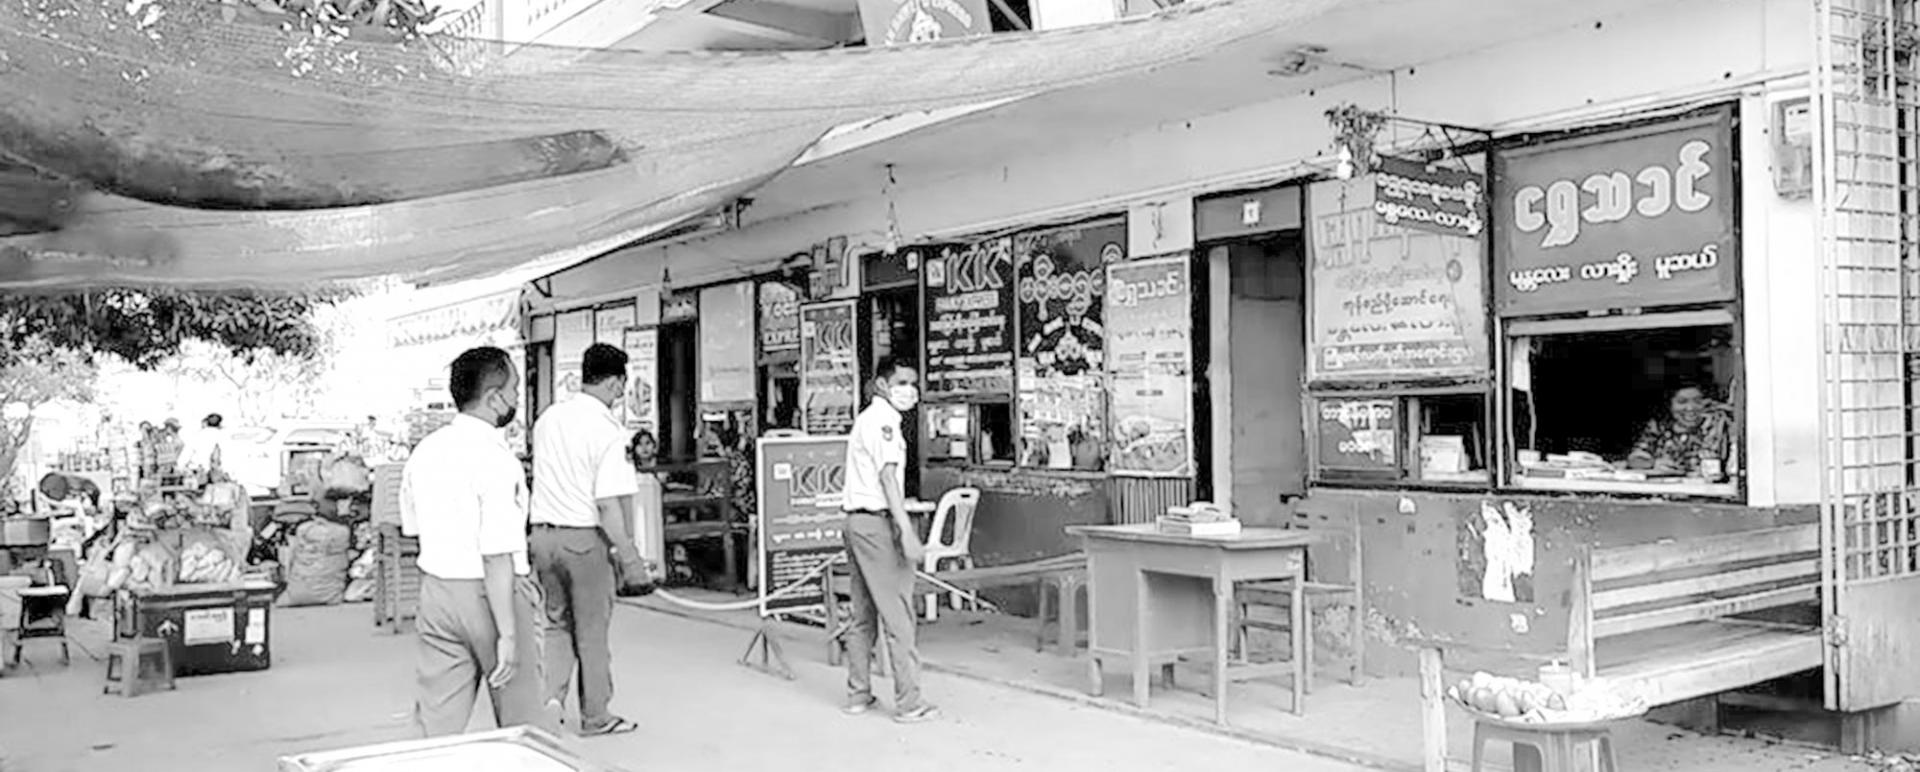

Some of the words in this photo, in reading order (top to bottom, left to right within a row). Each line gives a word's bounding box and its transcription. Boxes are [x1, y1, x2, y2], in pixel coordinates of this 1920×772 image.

[945, 247, 1004, 294] KK
[1510, 267, 1571, 292] မန္တလေး
[1655, 245, 1718, 279] မူဆယ်
[790, 463, 846, 495] KK
